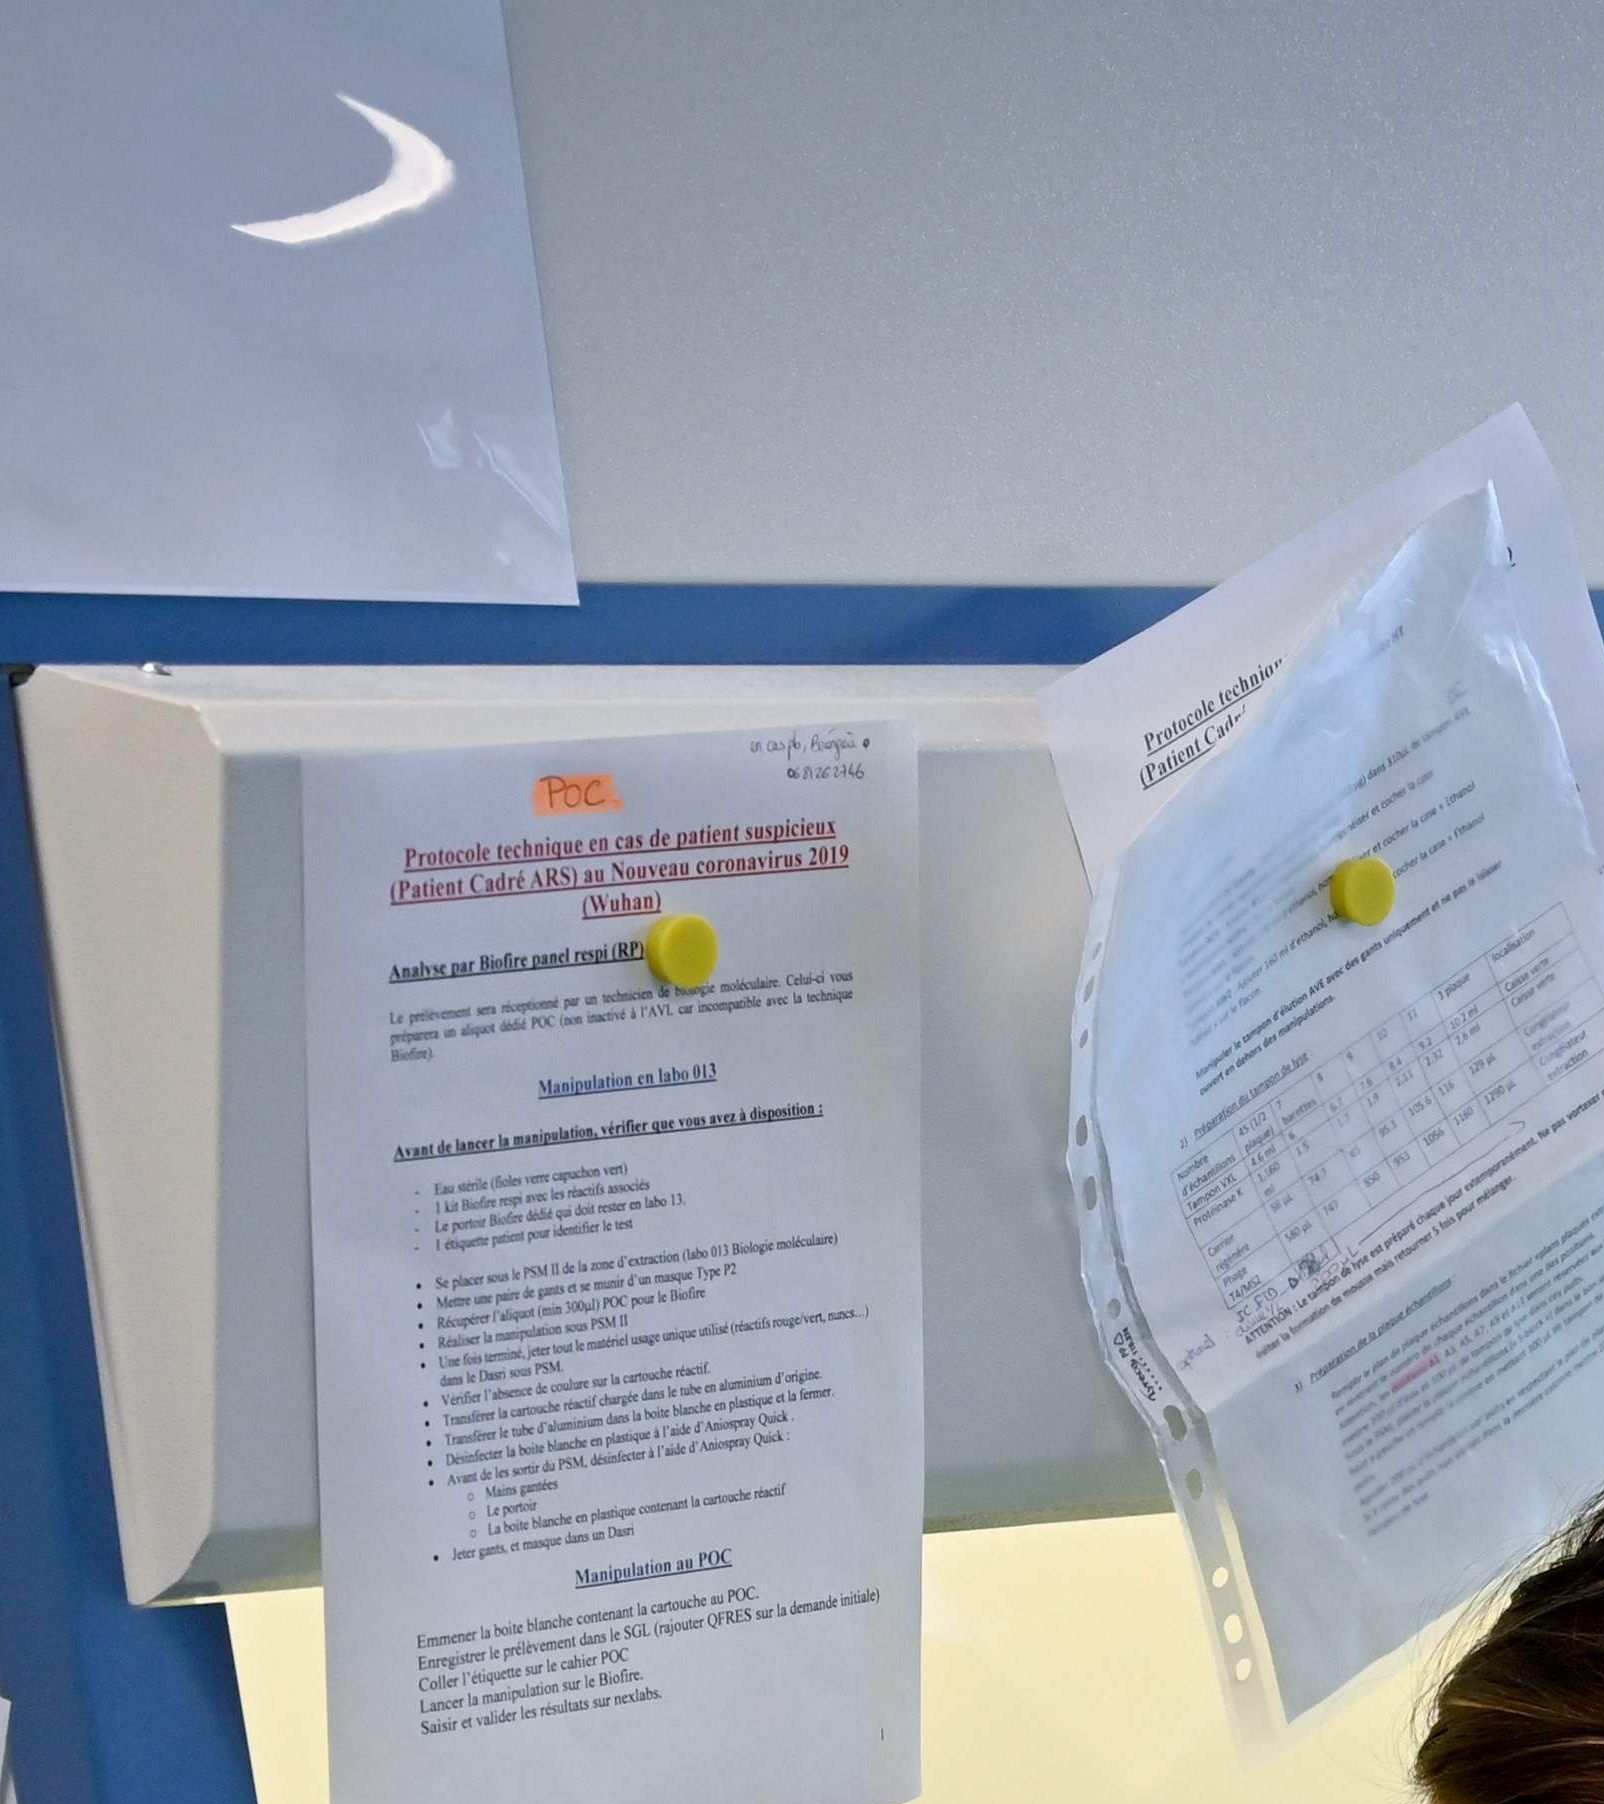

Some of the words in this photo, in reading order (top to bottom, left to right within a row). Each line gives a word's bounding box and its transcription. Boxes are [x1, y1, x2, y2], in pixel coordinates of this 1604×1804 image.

[1143, 698, 1215, 752] Protocole
[1140, 737, 1202, 789] (Patient
[405, 845, 490, 870] Protocole
[496, 839, 582, 862] technique
[588, 840, 608, 855] en
[614, 837, 643, 853] cas
[648, 831, 670, 851] de
[676, 825, 738, 851] patient
[745, 821, 834, 844] suspicieux
[389, 875, 462, 903] (Patient
[469, 870, 524, 894] Cadré
[531, 866, 577, 889] ARS)
[583, 869, 604, 885] au
[611, 862, 689, 883] Nouveau
[695, 851, 802, 877] coronavirus
[809, 846, 849, 868] 2019
[581, 892, 661, 921] (Wuhan)
[390, 961, 445, 980] Analyse
[450, 960, 473, 977] par
[479, 953, 527, 972] Biofire
[531, 948, 569, 969] panel
[573, 944, 608, 964] respi
[611, 941, 647, 962] (RP)
[538, 1071, 632, 1096] Manipulation
[637, 1072, 654, 1087] en
[658, 1065, 689, 1085] labo
[692, 1062, 716, 1082] 013
[394, 1139, 433, 1159] Avant
[436, 1138, 451, 1154] de
[454, 1136, 494, 1152] lancer
[497, 1131, 509, 1147] la
[600, 1117, 647, 1136] vérifier
[651, 1116, 674, 1132] que
[678, 1113, 706, 1128] vous
[709, 1110, 735, 1124] avez
[738, 1105, 746, 1121] à
[749, 1099, 814, 1120] disposition
[1246, 1306, 1292, 1344] ATTENTION
[575, 1559, 672, 1587] Manipulation
[676, 1559, 693, 1575] au
[698, 1550, 731, 1572] POC
[416, 1631, 476, 1648] Emmener
[480, 1627, 491, 1641] la
[493, 1623, 523, 1639] boite
[526, 1616, 573, 1635] blanche
[576, 1606, 633, 1628] contenant
[637, 1605, 648, 1619] la
[650, 1596, 707, 1617] cartouche
[710, 1596, 724, 1608] au
[727, 1587, 761, 1605] POC.
[417, 1651, 485, 1671] Enregistrer
[489, 1648, 500, 1662] le
[502, 1636, 576, 1662] prélèvement
[578, 1635, 607, 1649] dans
[609, 1631, 620, 1645] le
[624, 1626, 650, 1643] SGL
[653, 1620, 703, 1641] (rajouter
[707, 1610, 752, 1633] QFRES
[755, 1611, 772, 1623] sur
[776, 1606, 787, 1620] la
[789, 1598, 837, 1618] demande
[840, 1590, 880, 1610] initiale)
[418, 1675, 458, 1692] Coller
[524, 1665, 542, 1677] sur
[546, 1660, 557, 1674] le
[560, 1655, 596, 1672] cahier
[600, 1650, 625, 1666] POC
[419, 1697, 463, 1713] Lancer
[467, 1693, 479, 1707] la
[481, 1682, 559, 1705] manipulation
[562, 1681, 580, 1693] sur
[584, 1677, 595, 1690] le
[598, 1671, 643, 1688] Biofire.
[420, 1717, 457, 1735] Saisir
[460, 1714, 472, 1729] et
[476, 1710, 516, 1727] valider
[520, 1707, 537, 1721] les
[539, 1699, 589, 1718] résultats
[592, 1698, 610, 1710] sur
[613, 1689, 663, 1708] nexlabs.
